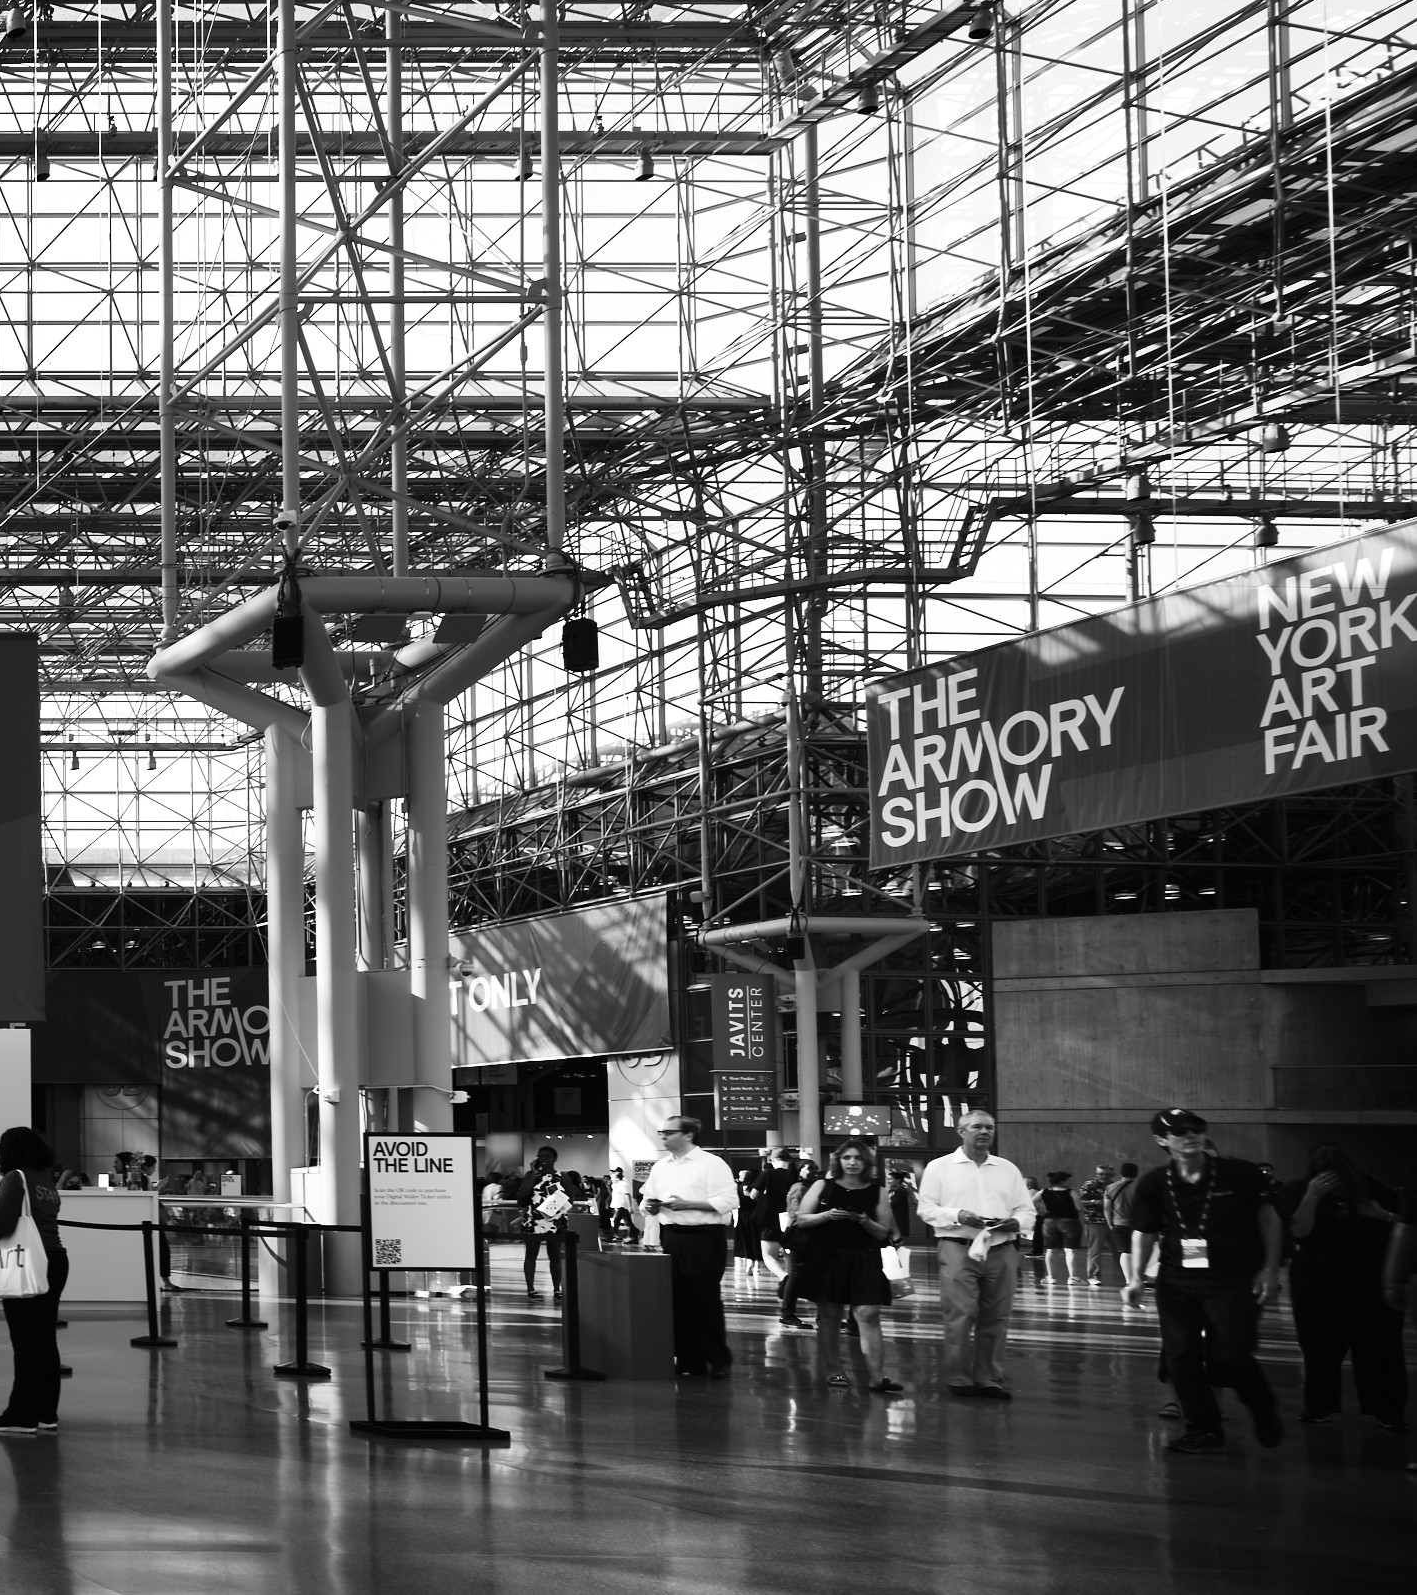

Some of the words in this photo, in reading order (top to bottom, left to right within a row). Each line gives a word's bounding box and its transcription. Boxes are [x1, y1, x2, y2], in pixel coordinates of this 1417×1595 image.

[1257, 547, 1395, 631] NEW
[1255, 592, 1417, 676] YORK
[877, 667, 981, 741] THE
[1259, 655, 1377, 728] ART
[877, 686, 1125, 797] ARMORY
[1264, 706, 1391, 775] FAIR
[881, 763, 1053, 848] SHOW
[163, 1005, 270, 1039] ARMO
[164, 977, 231, 1008] THE
[468, 967, 541, 1013] ONLY
[727, 987, 746, 1057] JAVITS
[750, 986, 764, 1057] CENTER
[165, 1038, 271, 1069] SHOW
[373, 1141, 428, 1157] AVOID
[373, 1157, 409, 1173] THE
[414, 1157, 454, 1173] LINE
